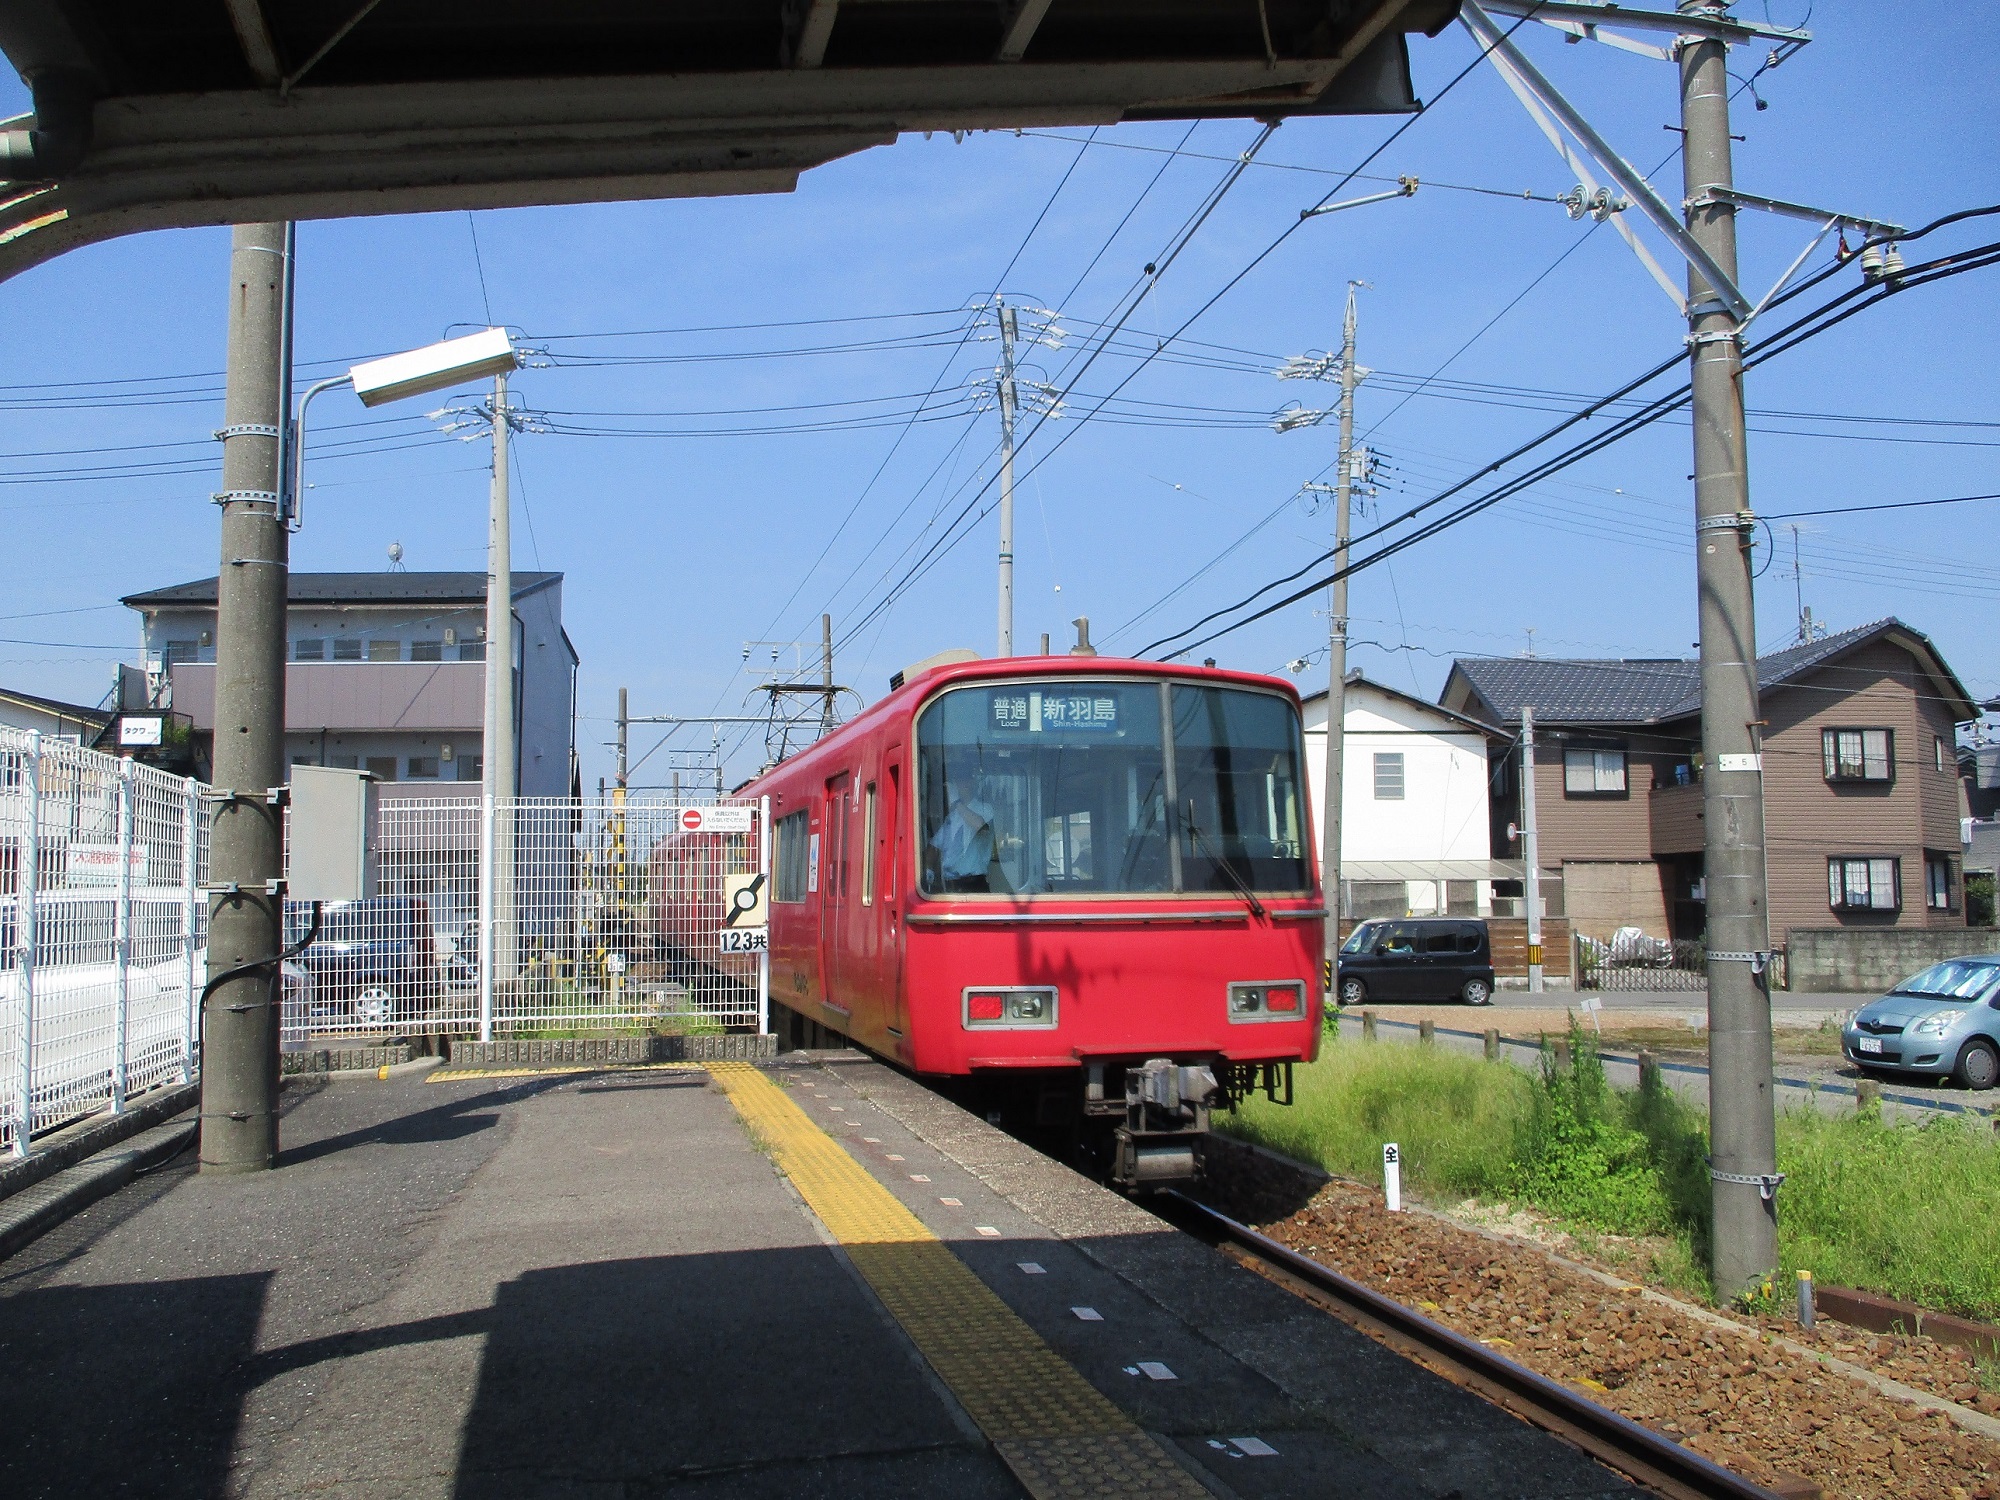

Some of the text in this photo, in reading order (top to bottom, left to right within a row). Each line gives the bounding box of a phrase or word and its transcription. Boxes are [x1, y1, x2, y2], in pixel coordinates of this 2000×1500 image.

[994, 696, 1116, 721] 普通 新羽島
[1001, 720, 1020, 728] Local
[1385, 1147, 1397, 1163] 全
